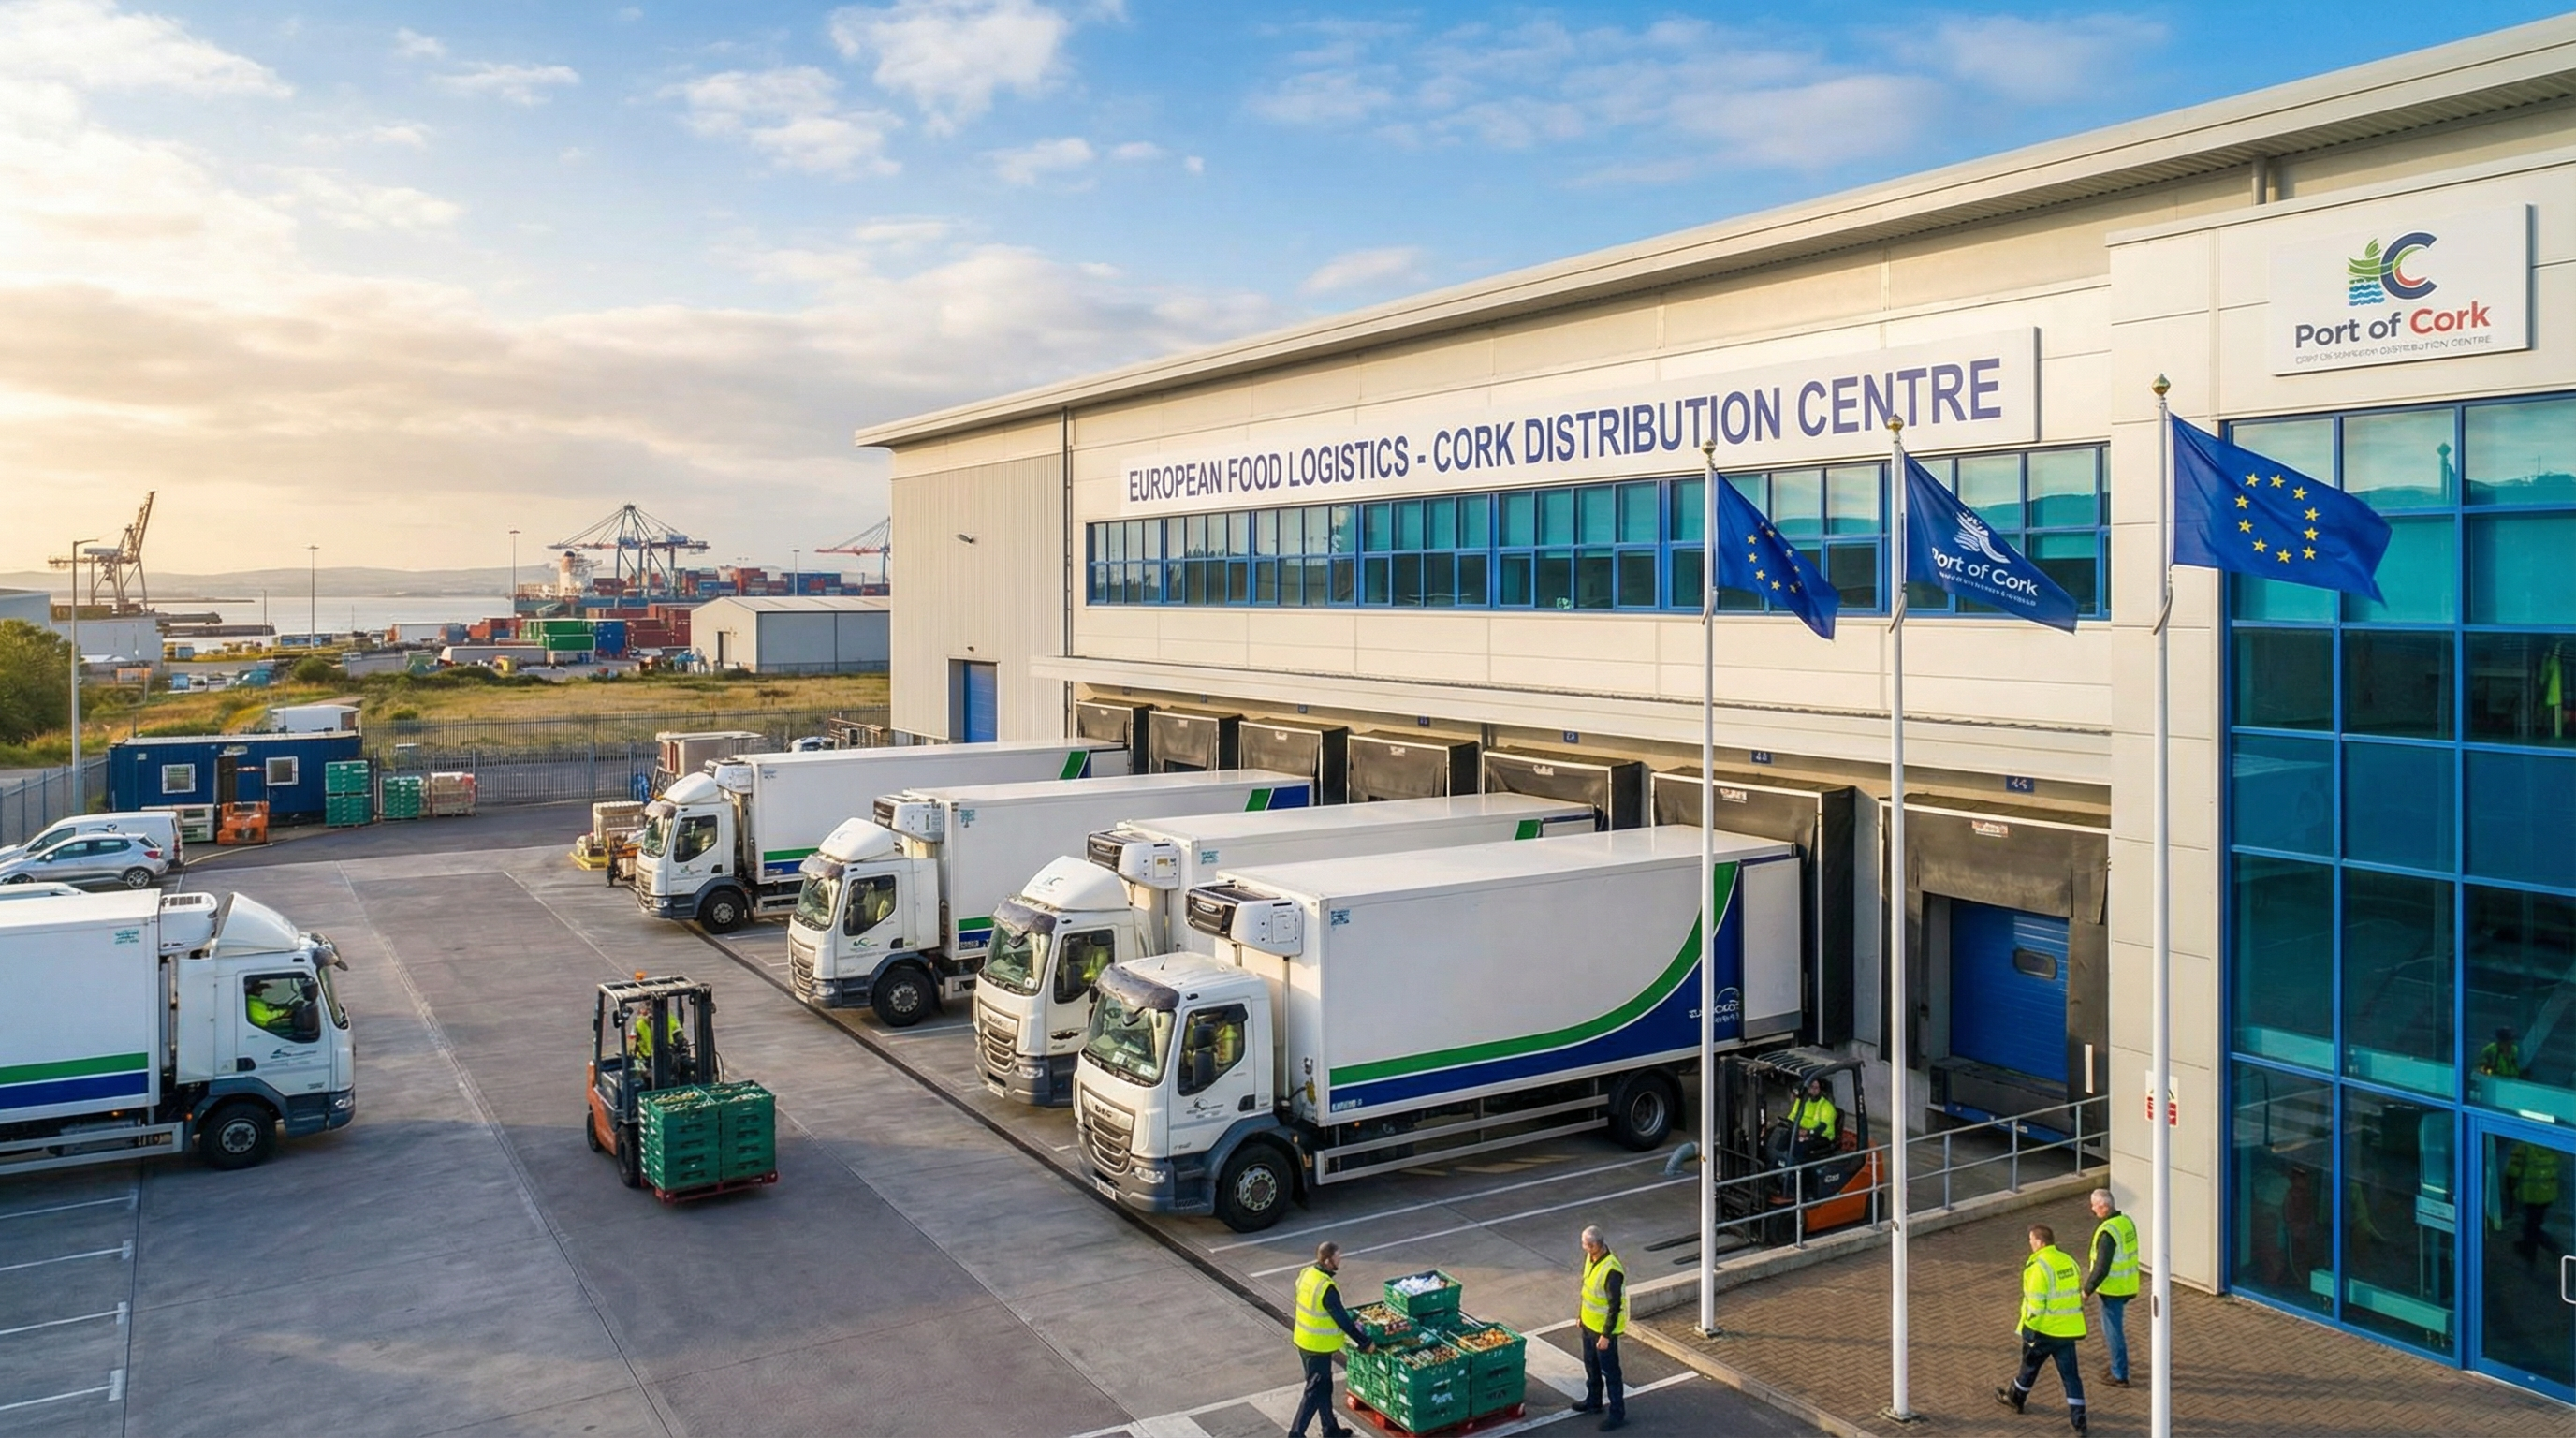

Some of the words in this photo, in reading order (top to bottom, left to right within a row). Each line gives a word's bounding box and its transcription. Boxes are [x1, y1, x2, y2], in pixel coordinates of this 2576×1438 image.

[2295, 319, 2360, 349] Port
[2368, 311, 2402, 340] of
[2410, 301, 2491, 335] Cork
[1130, 461, 1222, 503] EUROPEAN
[1228, 453, 1282, 493] FOOD
[1289, 436, 1410, 488] LOGISTICS
[1433, 421, 1515, 474] CORK
[1525, 387, 1781, 465] DISTRIBUTION
[1798, 358, 2002, 438] CENTRE
[1967, 564, 1990, 580] of
[1991, 568, 2039, 597] Cork
